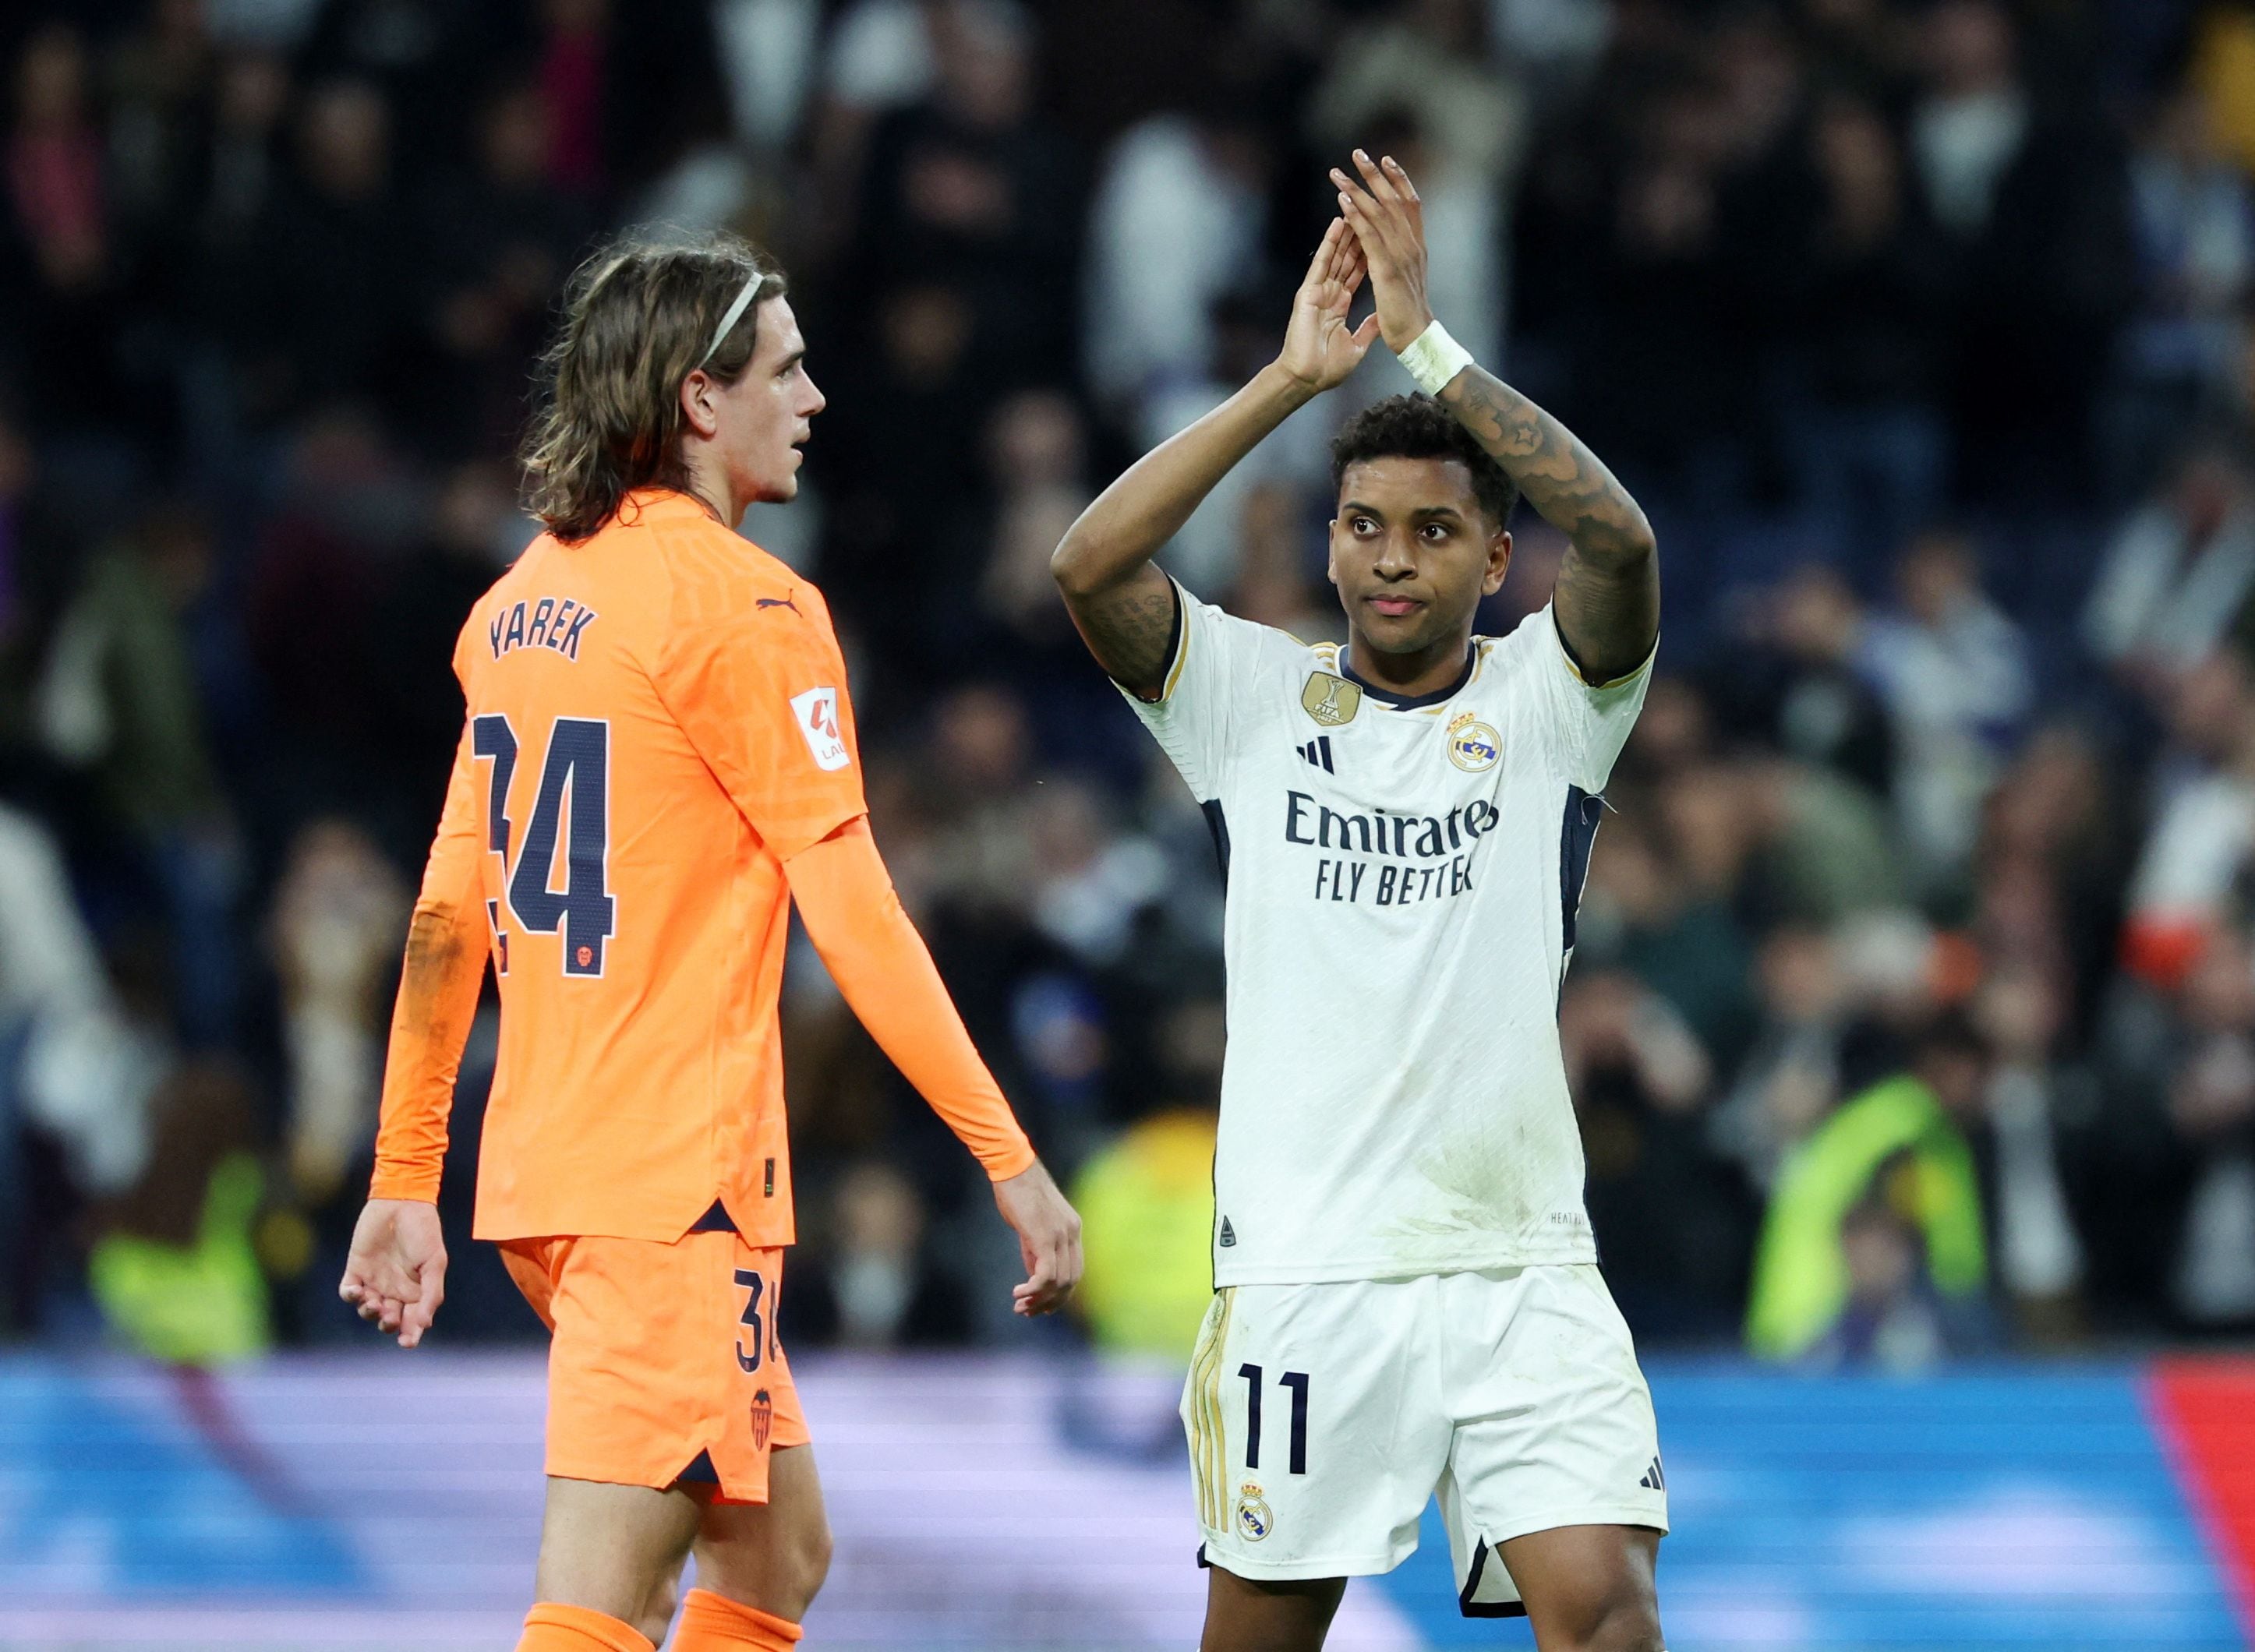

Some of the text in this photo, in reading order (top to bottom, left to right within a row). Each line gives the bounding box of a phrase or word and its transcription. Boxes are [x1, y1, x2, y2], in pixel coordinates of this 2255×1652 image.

[490, 596, 599, 662] YAREK
[1315, 859, 1366, 903] FLY
[733, 1268, 778, 1374] 3
[1237, 1362, 1310, 1475] 11
